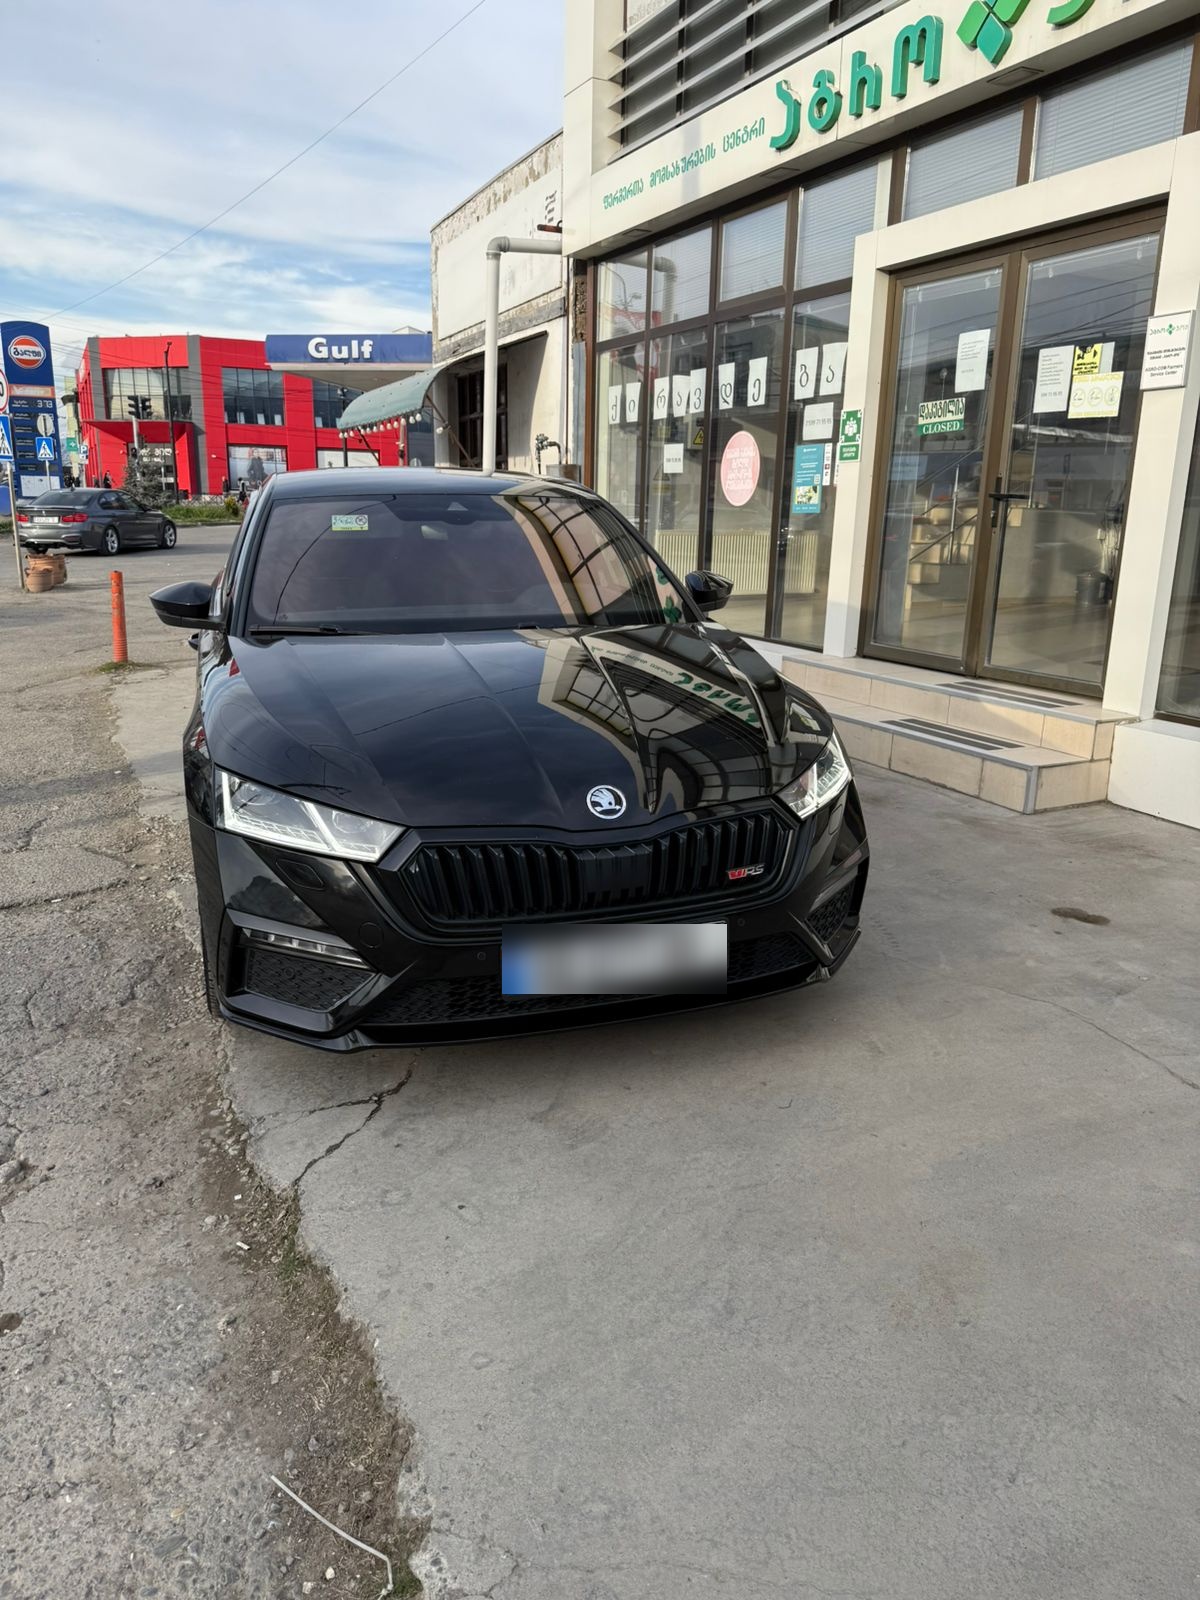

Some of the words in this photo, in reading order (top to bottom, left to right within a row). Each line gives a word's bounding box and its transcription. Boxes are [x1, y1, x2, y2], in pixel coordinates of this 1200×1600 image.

[769, 14, 944, 151] აგრო
[723, 117, 766, 153] ცენტრი
[307, 336, 374, 360] Gulf
[919, 398, 965, 421] დაკეტილია
[922, 420, 960, 435] CLOSED
